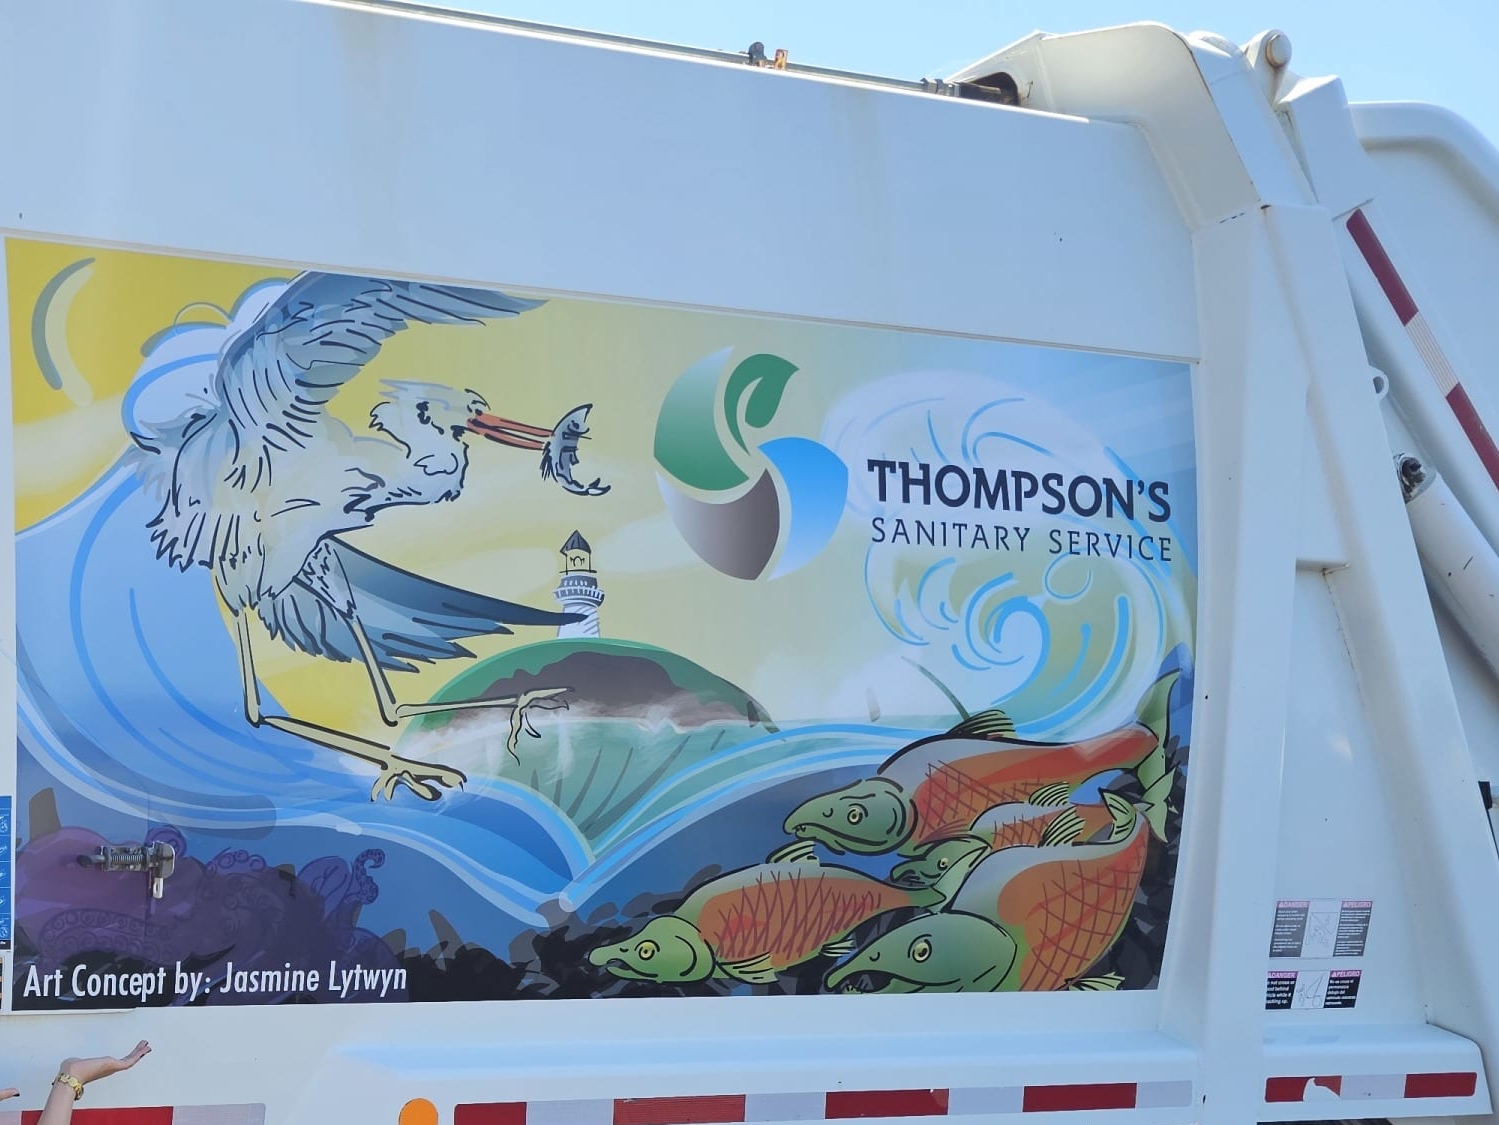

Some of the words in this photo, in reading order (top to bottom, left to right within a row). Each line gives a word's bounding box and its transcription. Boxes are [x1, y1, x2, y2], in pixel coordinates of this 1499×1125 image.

[867, 458, 1172, 523] THOMPSON'S
[871, 516, 1031, 552] SANITARY
[1048, 529, 1172, 562] SERVICE
[22, 964, 63, 997] Art
[71, 963, 167, 1002] Concept
[174, 961, 211, 1001] by:
[219, 962, 320, 994] Jasmine
[328, 960, 408, 998] Lytwyn
